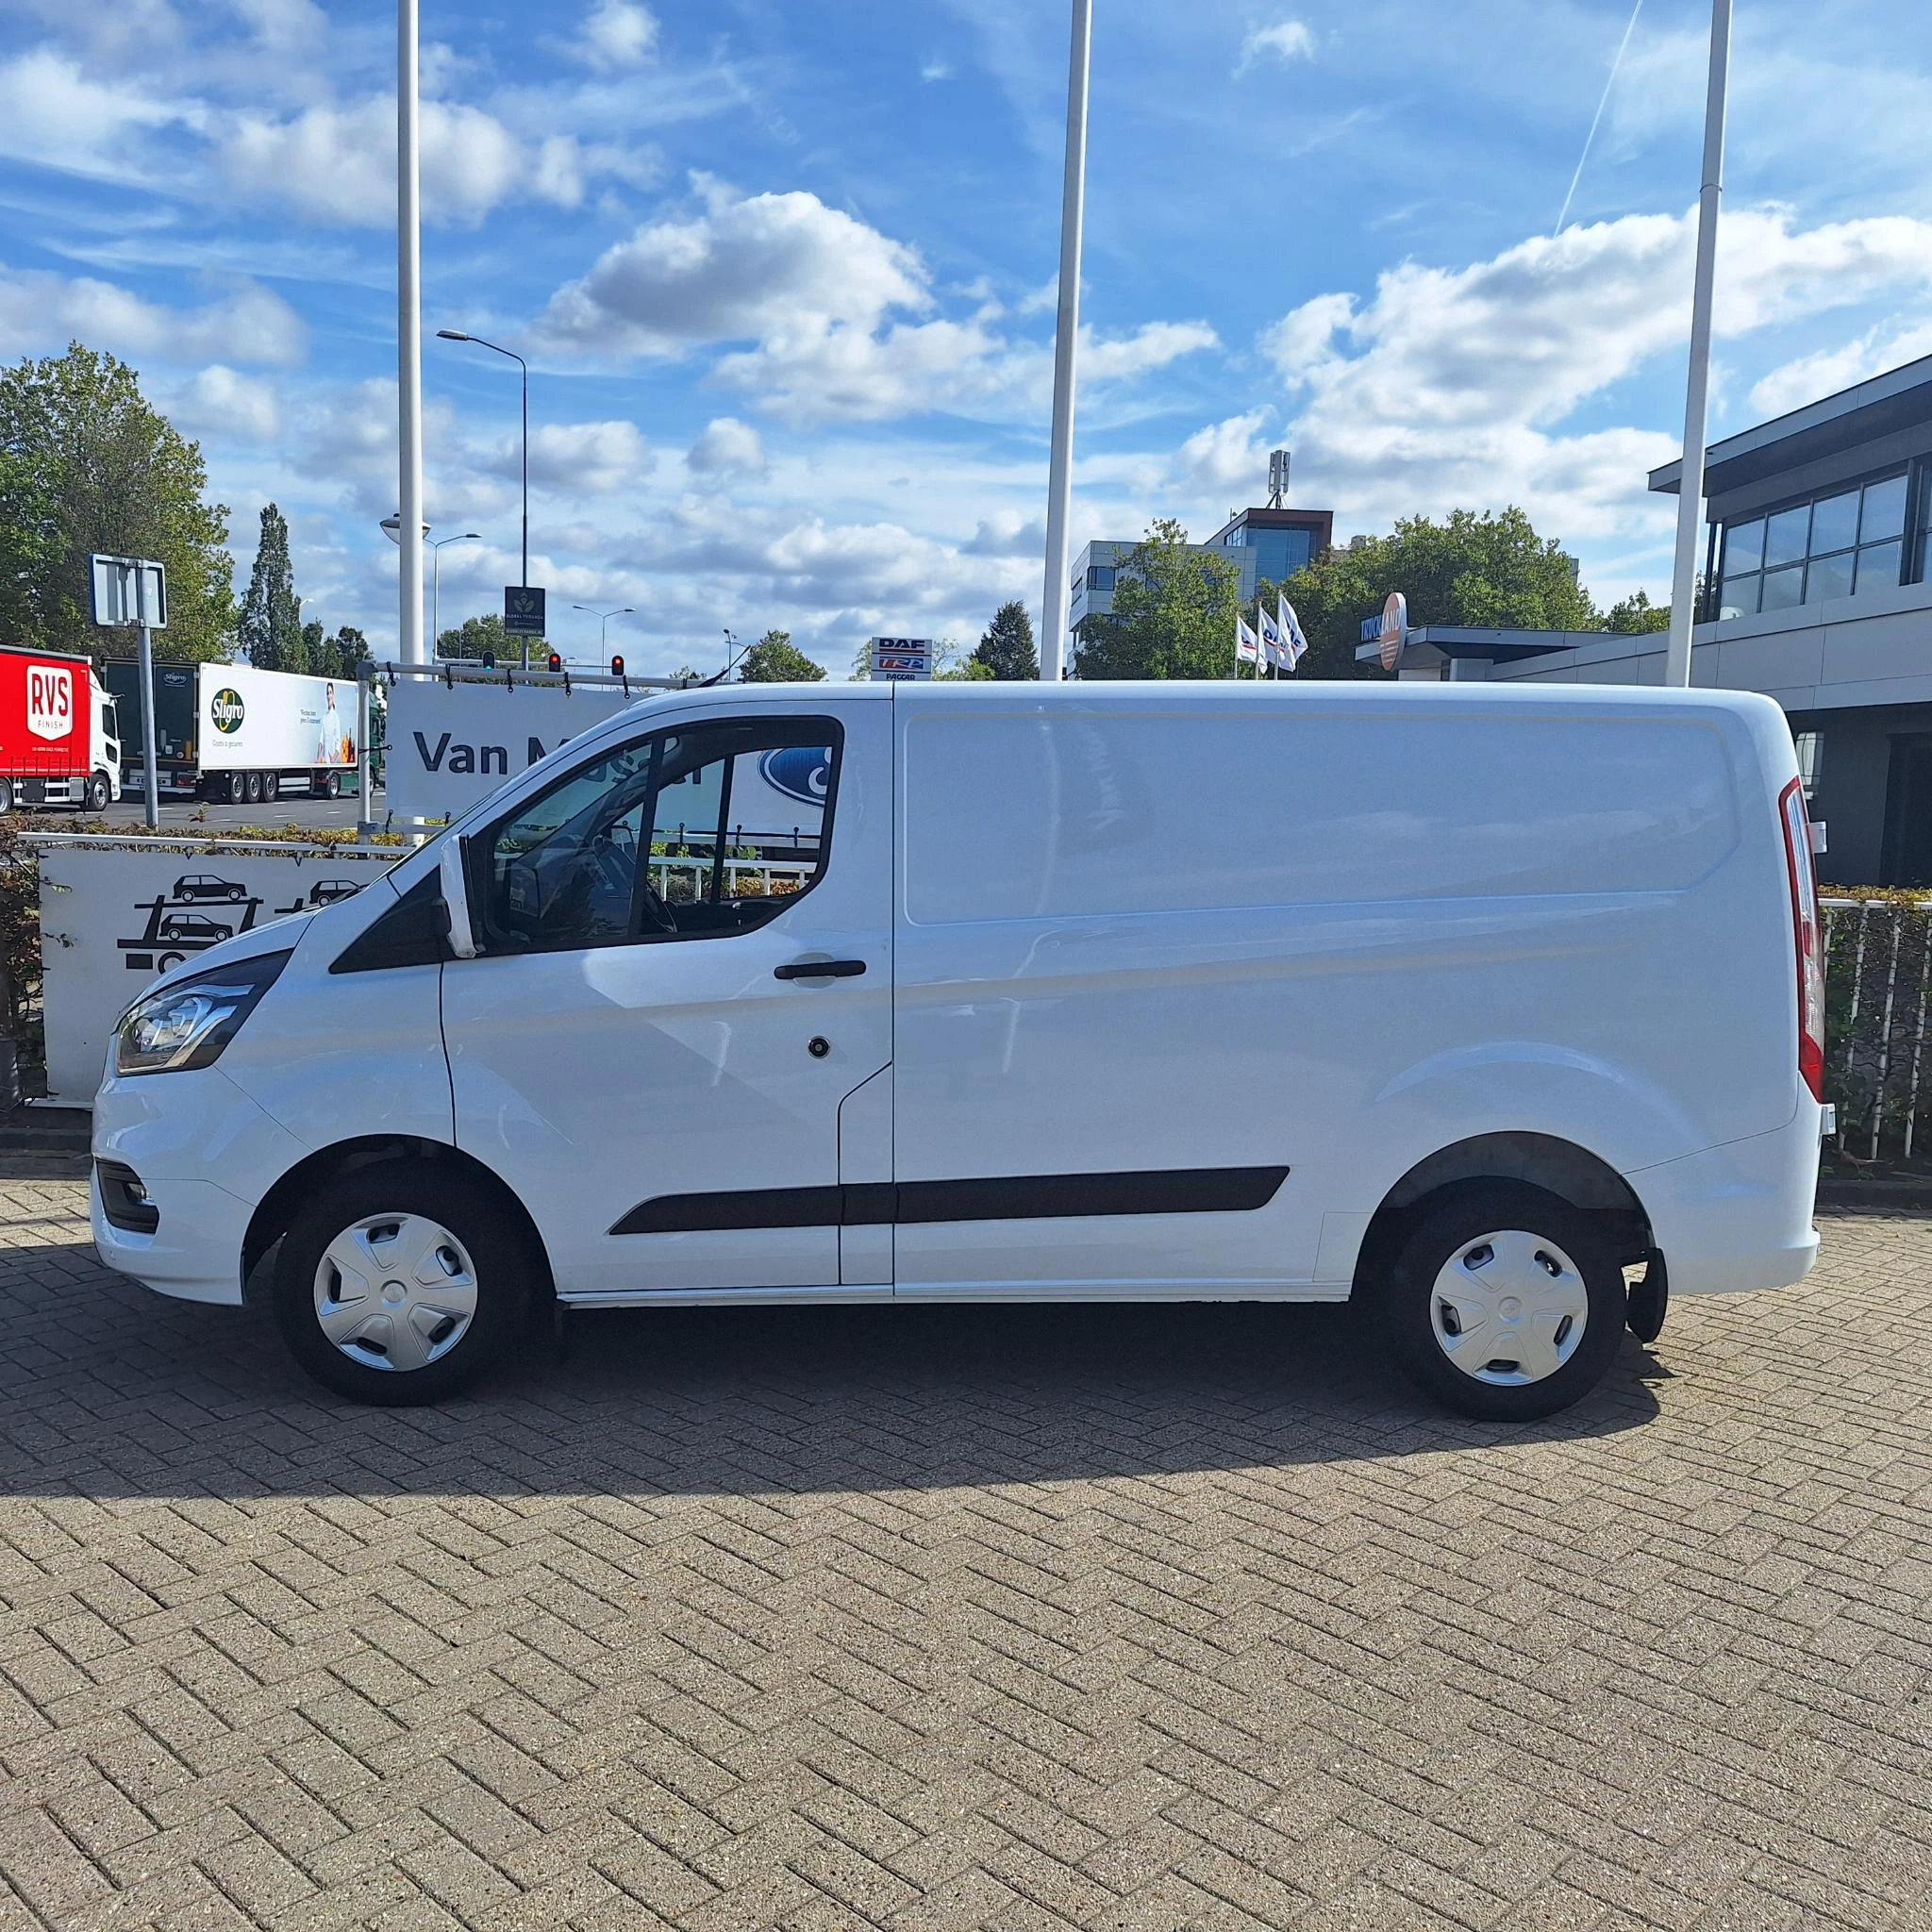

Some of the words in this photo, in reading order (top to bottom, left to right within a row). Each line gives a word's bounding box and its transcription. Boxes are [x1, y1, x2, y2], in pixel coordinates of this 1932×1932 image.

[879, 638, 925, 648] DAF
[31, 673, 69, 717] RVS
[212, 698, 243, 724] Sligro
[38, 720, 63, 729] FINISH
[413, 731, 508, 775] Van
